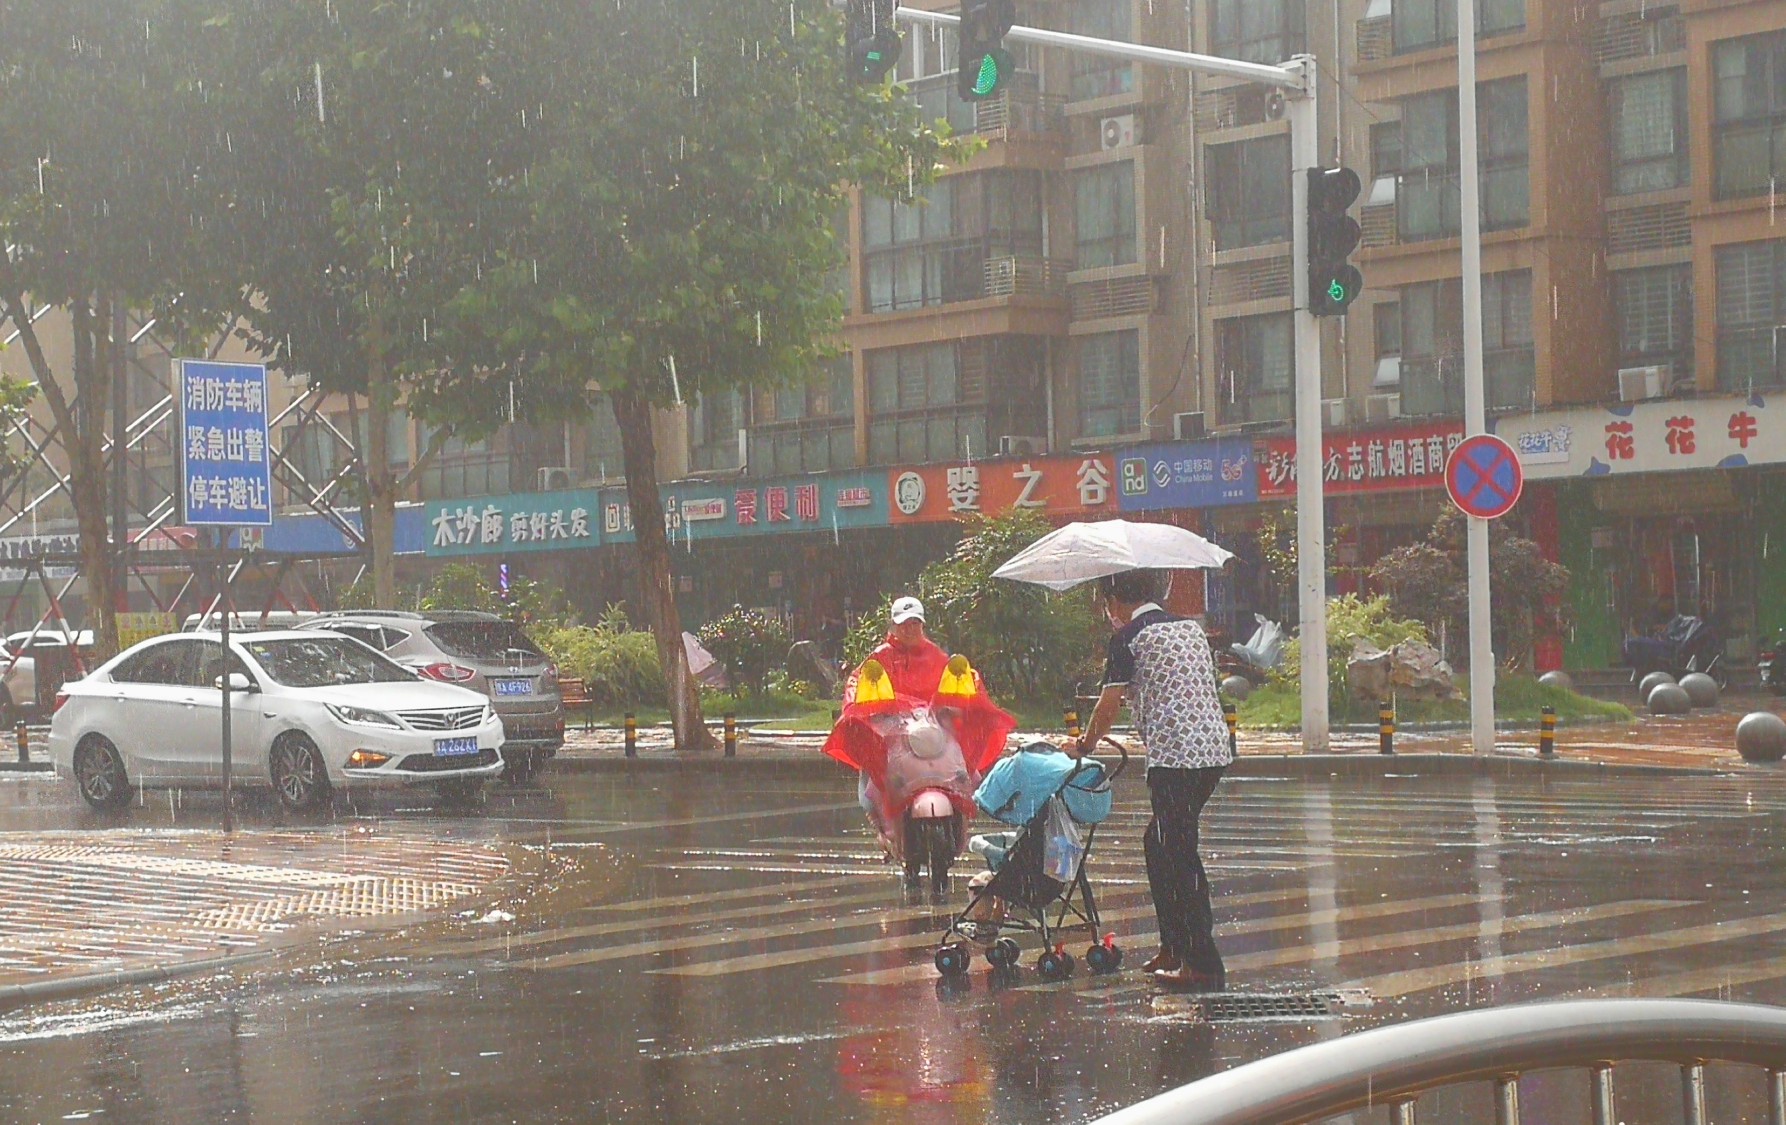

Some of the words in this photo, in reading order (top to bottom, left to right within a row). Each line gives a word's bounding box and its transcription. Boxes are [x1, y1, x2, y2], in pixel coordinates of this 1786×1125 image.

[187, 376, 263, 413] 消防车辆
[188, 425, 264, 462] 紧急出警
[1604, 410, 1757, 460] 花花牛
[1173, 458, 1213, 474] 中国移动
[189, 475, 267, 514] 停车避让
[947, 459, 1111, 512] 婴之谷
[510, 507, 590, 543] 剪好头发
